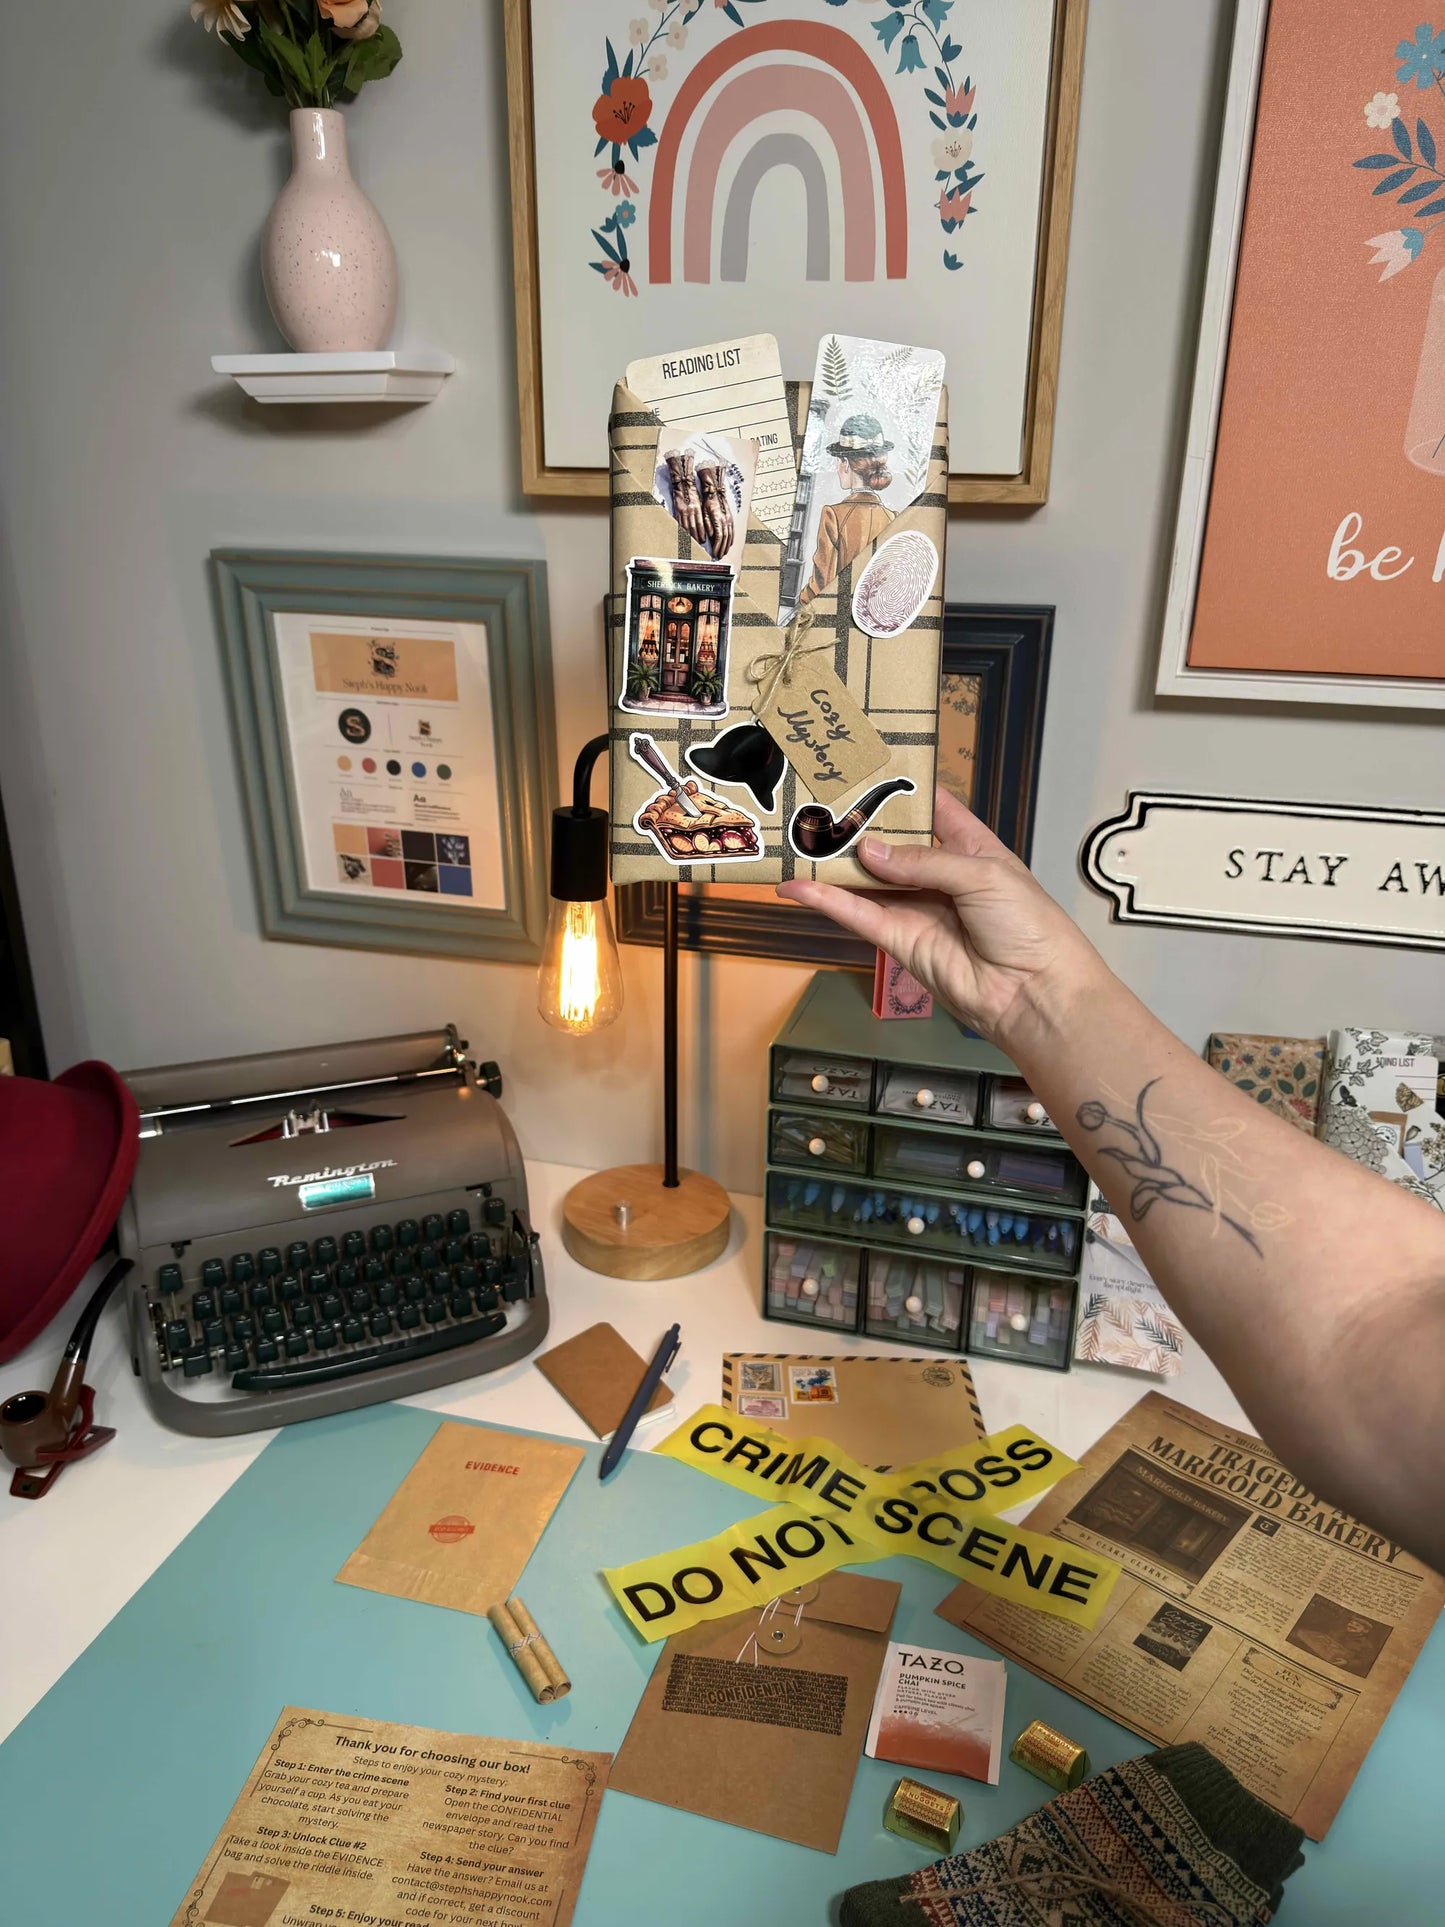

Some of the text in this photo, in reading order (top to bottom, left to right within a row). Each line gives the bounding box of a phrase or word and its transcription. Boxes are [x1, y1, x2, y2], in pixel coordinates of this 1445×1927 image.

[662, 348, 741, 380] READING LIST
[1327, 511, 1414, 581] be
[686, 583, 715, 592] BAKERY
[810, 689, 856, 743] Cozy
[777, 706, 848, 784] Mystery
[1224, 849, 1348, 887] STAY
[1399, 1058, 1415, 1067] LIST
[267, 1159, 399, 1188] Remington
[465, 1460, 520, 1476] EVIDENCE
[690, 1421, 866, 1512] CRIME
[873, 1498, 1099, 1606] SCENE
[1147, 1436, 1402, 1564] MARIGOLD BAKERY
[622, 1566, 724, 1623] DO
[911, 1438, 1053, 1501] OSS
[898, 1652, 964, 1675] TAZO
[706, 1679, 801, 1705] CONFIDENTIAL
[898, 1679, 919, 1687] CHAI
[899, 1673, 967, 1690] PUMPKIN SPICE
[335, 1735, 531, 1774] Thank you for choosing our box!
[274, 1759, 410, 1787] Step 1: Enter the crime scene
[353, 1756, 379, 1767] Steps
[381, 1760, 391, 1769] to
[393, 1763, 419, 1775] enjoy
[420, 1767, 442, 1778] your
[443, 1771, 466, 1782] cozy
[258, 1783, 300, 1796] yourself
[307, 1790, 327, 1800] cup.
[329, 1792, 341, 1802] As
[343, 1796, 361, 1805] you
[362, 1797, 378, 1807] eat
[379, 1801, 403, 1811] your
[264, 1770, 410, 1800] Grab your cozy tea and prepare
[445, 1784, 571, 1810] Step 2: Find your first clue
[261, 1795, 390, 1822] chocolate, start solving the
[298, 1815, 339, 1830] mystery.
[444, 1797, 564, 1822] Open the CONFIDENTIAL
[445, 1811, 554, 1834] envelope and read the
[257, 1826, 367, 1851] Step 3: Unlock Clue #2
[422, 1820, 476, 1838] newspaper
[507, 1833, 527, 1844] Can
[529, 1837, 548, 1847] you
[549, 1838, 570, 1849] find
[468, 1840, 515, 1855] the clue?
[223, 1847, 374, 1881] bag and solve the riddle inside.
[229, 1835, 251, 1847] Take
[259, 1840, 281, 1852] look
[282, 1844, 312, 1857] inside
[313, 1848, 331, 1859] the
[332, 1851, 384, 1868] EVIDENCE
[419, 1851, 544, 1878] Step 4: Send your answer
[391, 1875, 552, 1907] contact@stephshappynook.com
[406, 1863, 549, 1893] Have the answer? Email us at
[309, 1904, 333, 1918] Step
[334, 1909, 346, 1918] 5:
[347, 1910, 377, 1926] Enjoy
[378, 1916, 402, 1927] your
[397, 1889, 416, 1901] and
[418, 1892, 428, 1903] if
[427, 1895, 467, 1909] correct,
[468, 1901, 484, 1913] get
[496, 1905, 540, 1920] discount
[405, 1905, 431, 1918] code
[432, 1909, 450, 1920] for
[450, 1914, 473, 1925] your
